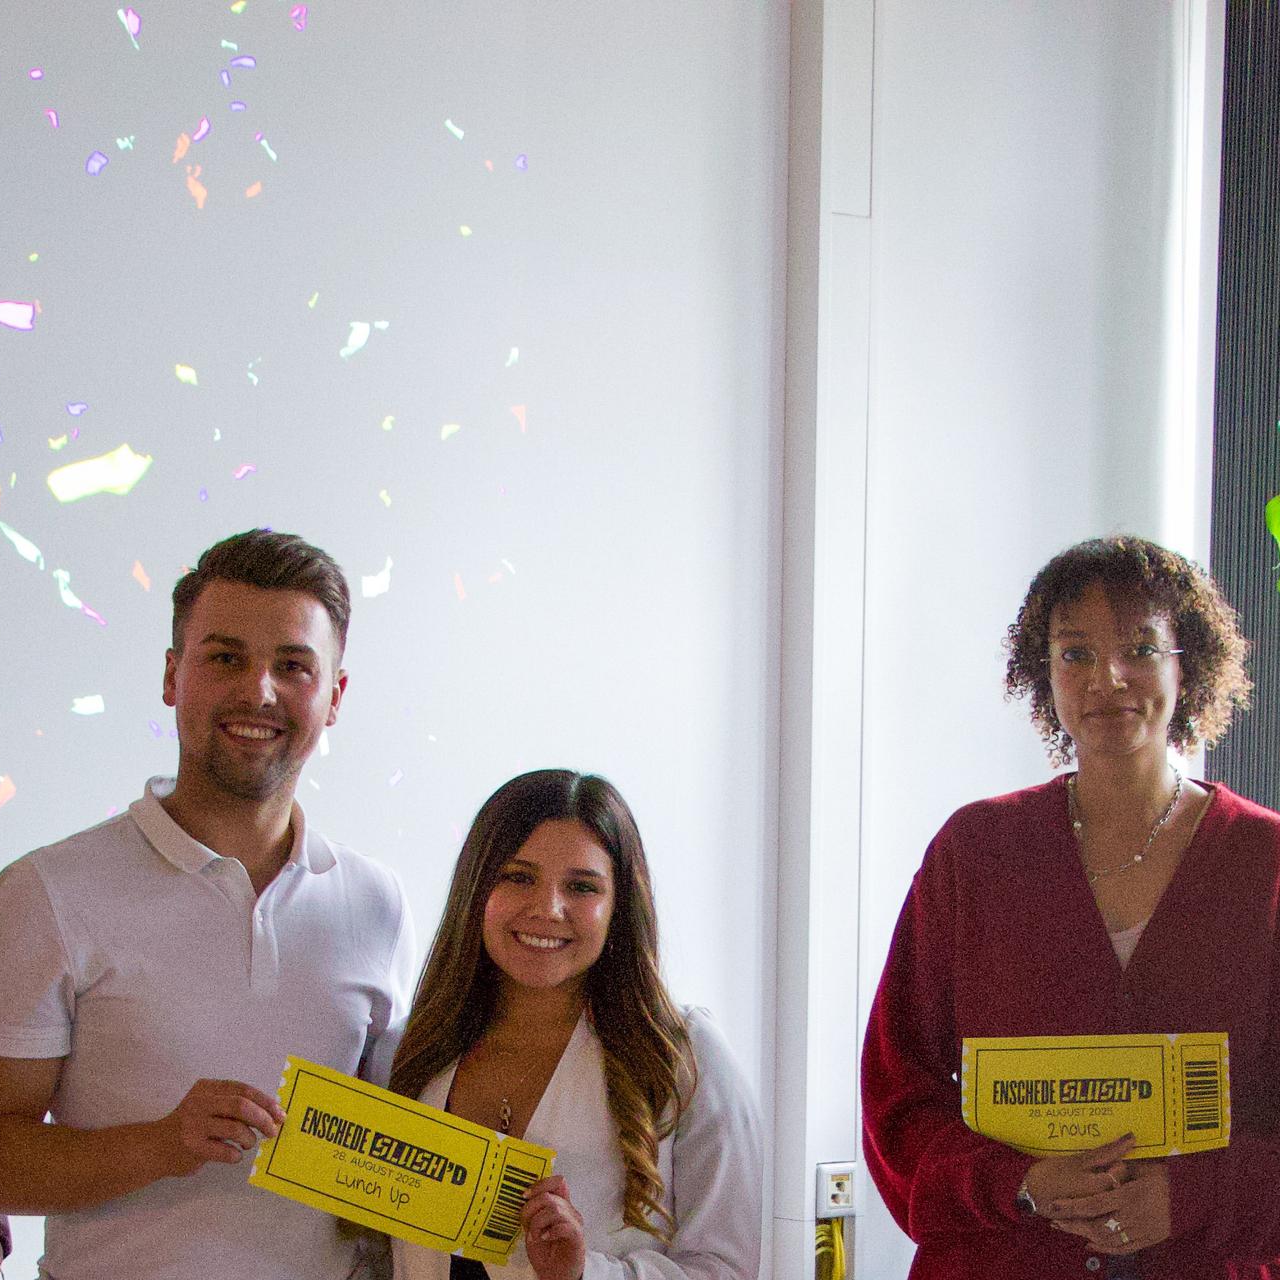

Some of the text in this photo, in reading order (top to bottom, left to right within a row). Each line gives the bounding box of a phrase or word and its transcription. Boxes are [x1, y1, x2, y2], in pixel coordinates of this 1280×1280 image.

[992, 1078, 1057, 1105] ENSCHEDE
[1046, 1106, 1086, 1118] AUGUST
[300, 1105, 372, 1155] ENSCHEDE
[335, 1167, 411, 1211] Lunch Up
[349, 1156, 394, 1180] AUGUST
[395, 1171, 422, 1189] 2025
